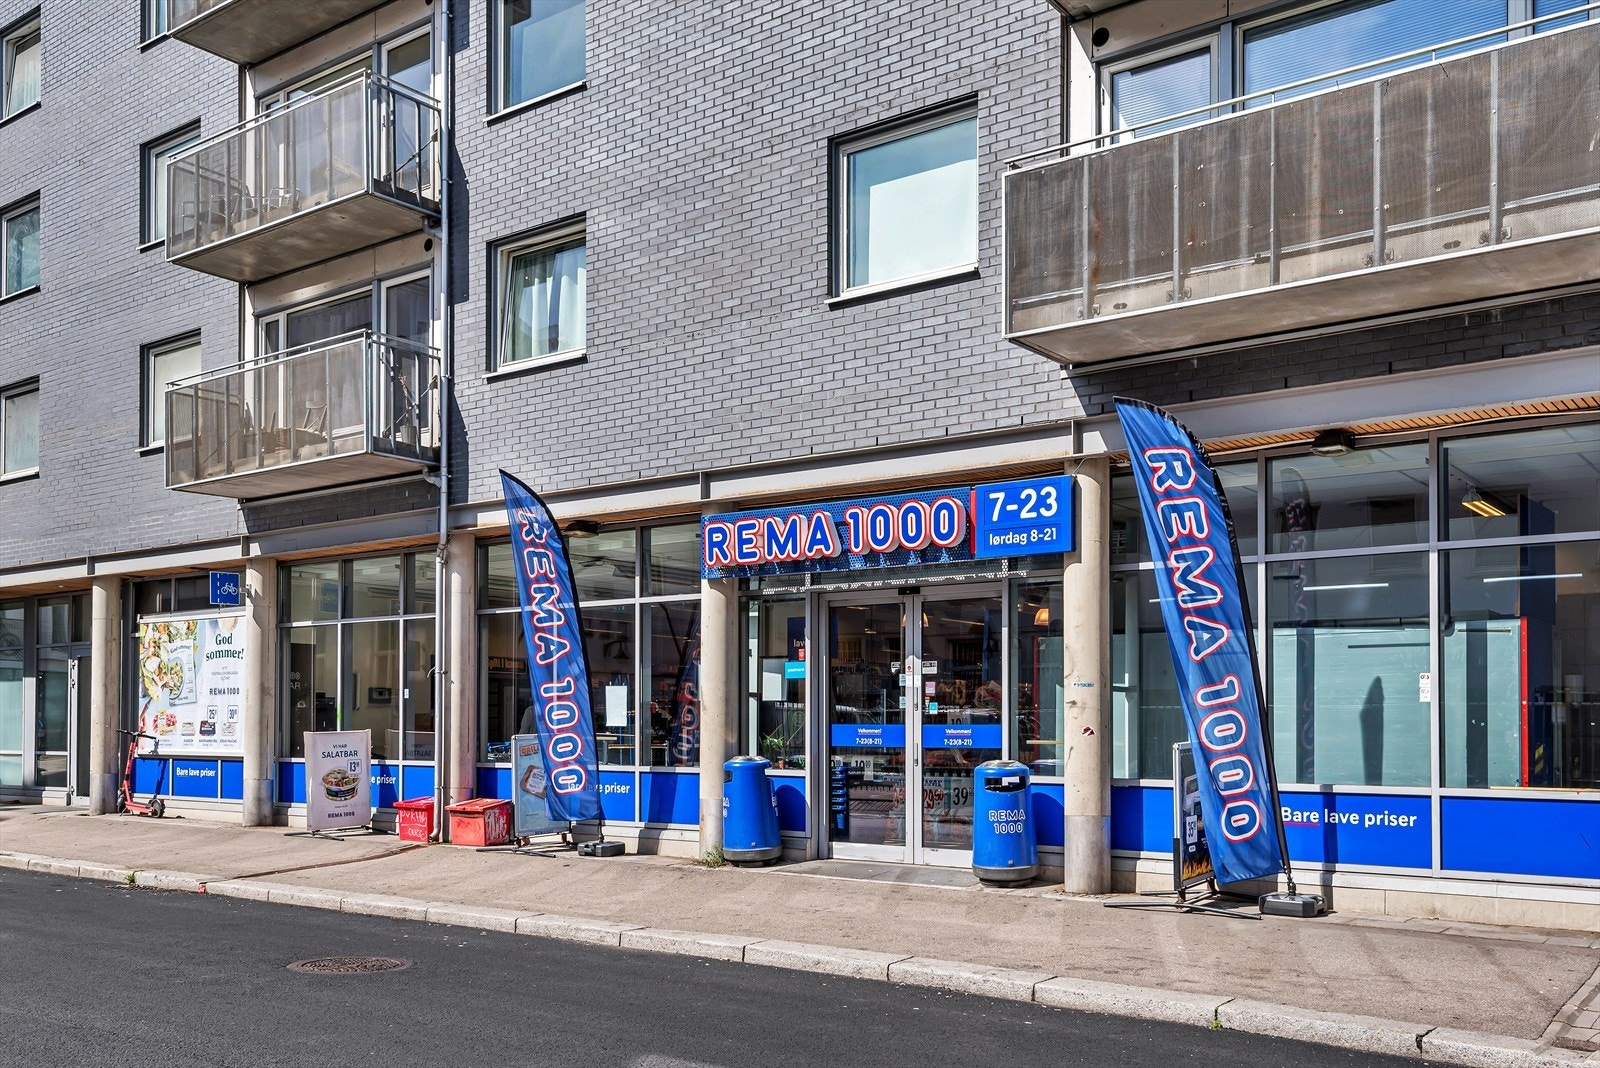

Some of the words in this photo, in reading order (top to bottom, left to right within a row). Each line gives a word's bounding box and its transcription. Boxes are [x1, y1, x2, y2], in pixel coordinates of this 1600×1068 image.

[989, 486, 1058, 522] 7-23
[704, 510, 840, 568] REMA
[844, 495, 966, 555] 1000
[989, 530, 1028, 547] lørdag
[1030, 528, 1057, 543] 8-21
[518, 507, 571, 666] REMA
[215, 632, 233, 646] God
[1144, 446, 1231, 663] REMA
[1196, 673, 1262, 843] 1000
[205, 648, 245, 661] sommer!
[209, 687, 226, 696] REMA
[540, 675, 587, 795] 1000
[943, 738, 973, 746] 7-23(8-21)
[321, 750, 359, 759] SALATBAR
[176, 767, 188, 776] Bare
[188, 768, 200, 776] lave
[200, 768, 216, 777] priser
[376, 774, 397, 785] priser
[604, 782, 631, 795] priser
[988, 809, 1026, 822] REMA
[1281, 806, 1320, 823] Bare
[1324, 808, 1360, 825] lave
[1364, 810, 1417, 828] priser
[993, 822, 1023, 834] 1000
